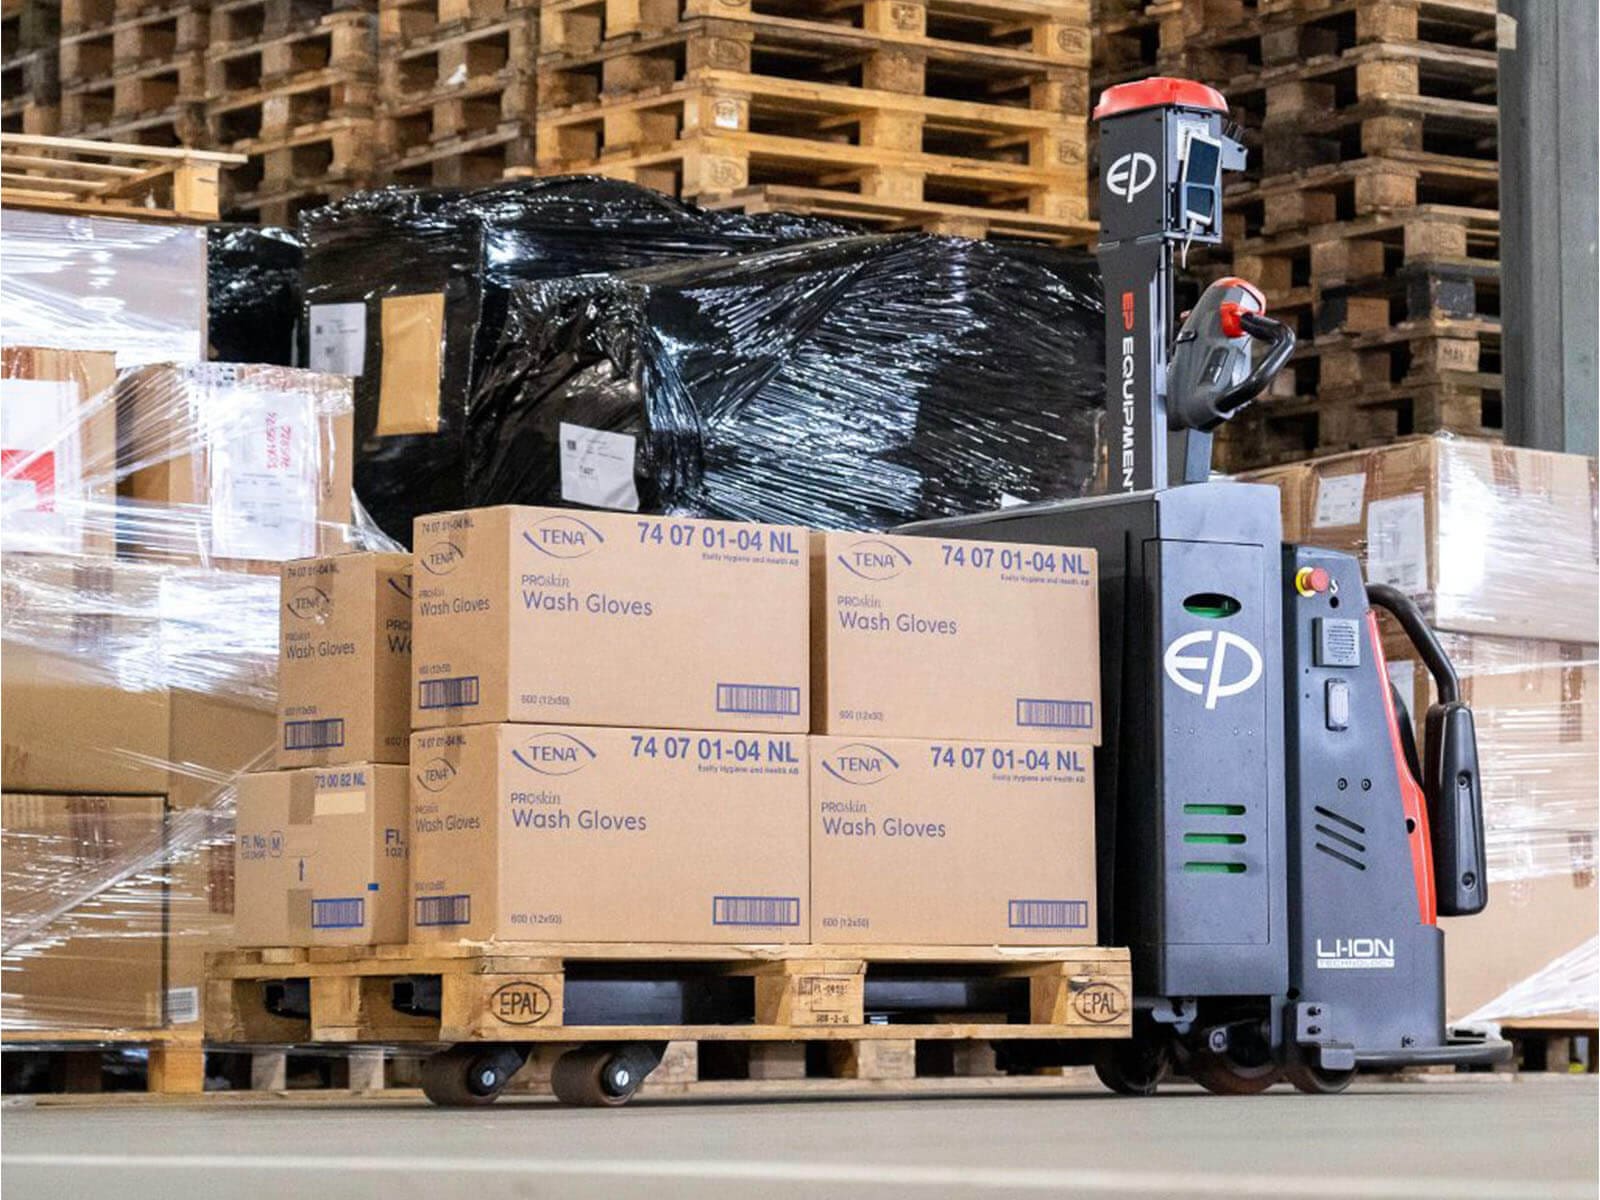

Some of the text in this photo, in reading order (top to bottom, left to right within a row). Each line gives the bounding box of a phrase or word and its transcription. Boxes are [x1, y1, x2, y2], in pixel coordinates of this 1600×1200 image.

[1106, 152, 1157, 203] EP
[1121, 291, 1134, 494] EP EQUIPMEN
[539, 528, 586, 546] TENA
[637, 521, 799, 554] 74 07 01-04 NL
[430, 551, 454, 565] TENA
[853, 552, 895, 568] TENA
[942, 545, 1089, 575] 74 07 01-04 NL
[521, 573, 570, 588] PROskin
[420, 597, 490, 616] Wash Gloves
[522, 590, 653, 616] Wash Gloves
[837, 594, 881, 608] PROskin
[839, 610, 957, 636] Wash Gloves
[287, 639, 355, 659] Wash Gloves
[1164, 631, 1263, 710] EP
[529, 745, 577, 762] TENA
[631, 735, 798, 763] 74 07 01-04 NL
[837, 756, 882, 772] TENA
[931, 747, 1085, 772] 74 07 01-04 NL
[314, 775, 325, 788] 73
[327, 774, 338, 787] 00
[353, 772, 366, 786] NL
[425, 769, 448, 782] TENA
[510, 791, 560, 805] PROskin
[821, 800, 867, 813] PROskin
[416, 815, 481, 833] Wash Gloves
[512, 809, 647, 831] Wash Gloves
[823, 817, 946, 837] Wash Gloves
[1317, 938, 1394, 957] LI-ION
[500, 992, 543, 1016] EPAL
[1083, 992, 1118, 1015] EPAL
